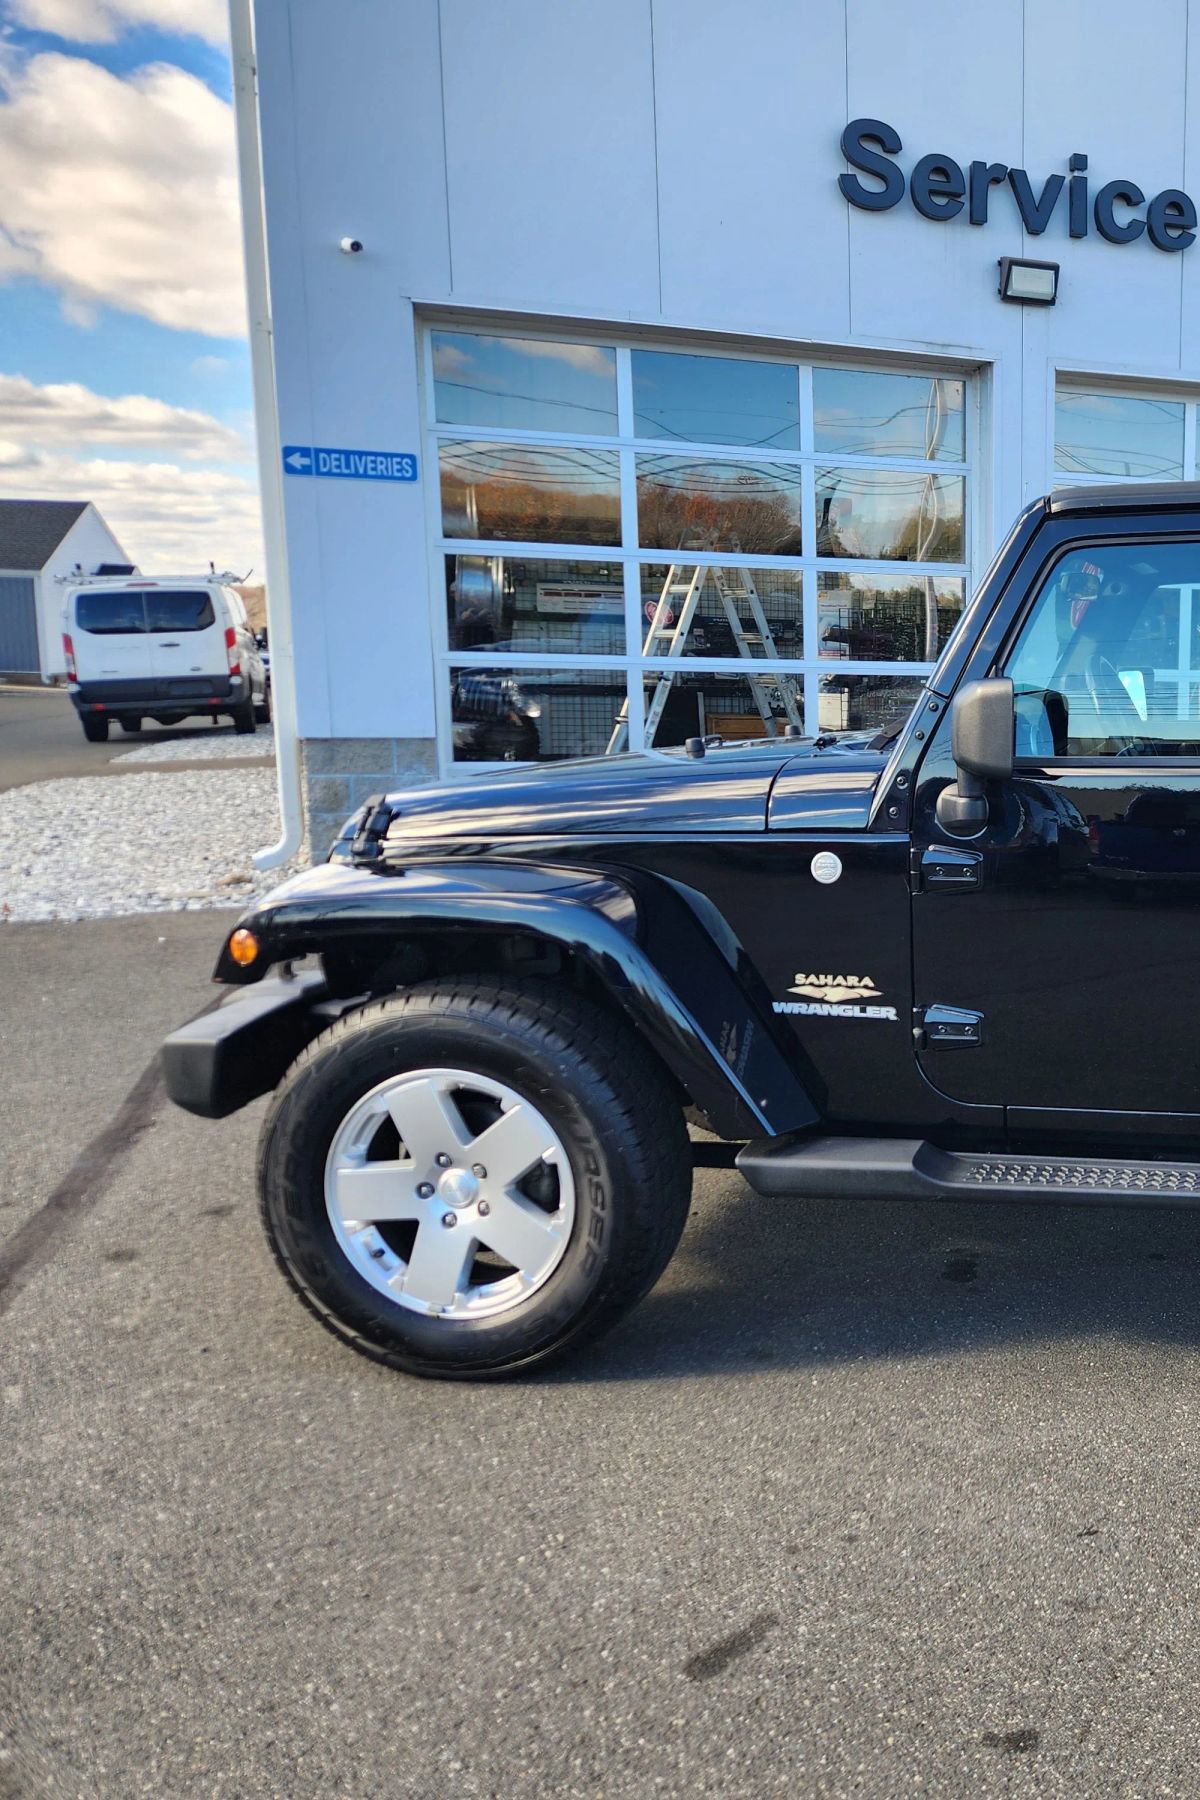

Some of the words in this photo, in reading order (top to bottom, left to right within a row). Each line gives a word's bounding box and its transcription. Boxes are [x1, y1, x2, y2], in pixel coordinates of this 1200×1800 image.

[838, 118, 1198, 253] Service
[318, 452, 413, 478] DELIVERIES
[794, 973, 875, 988] SAHARA
[771, 1001, 900, 1021] WRANGLER
